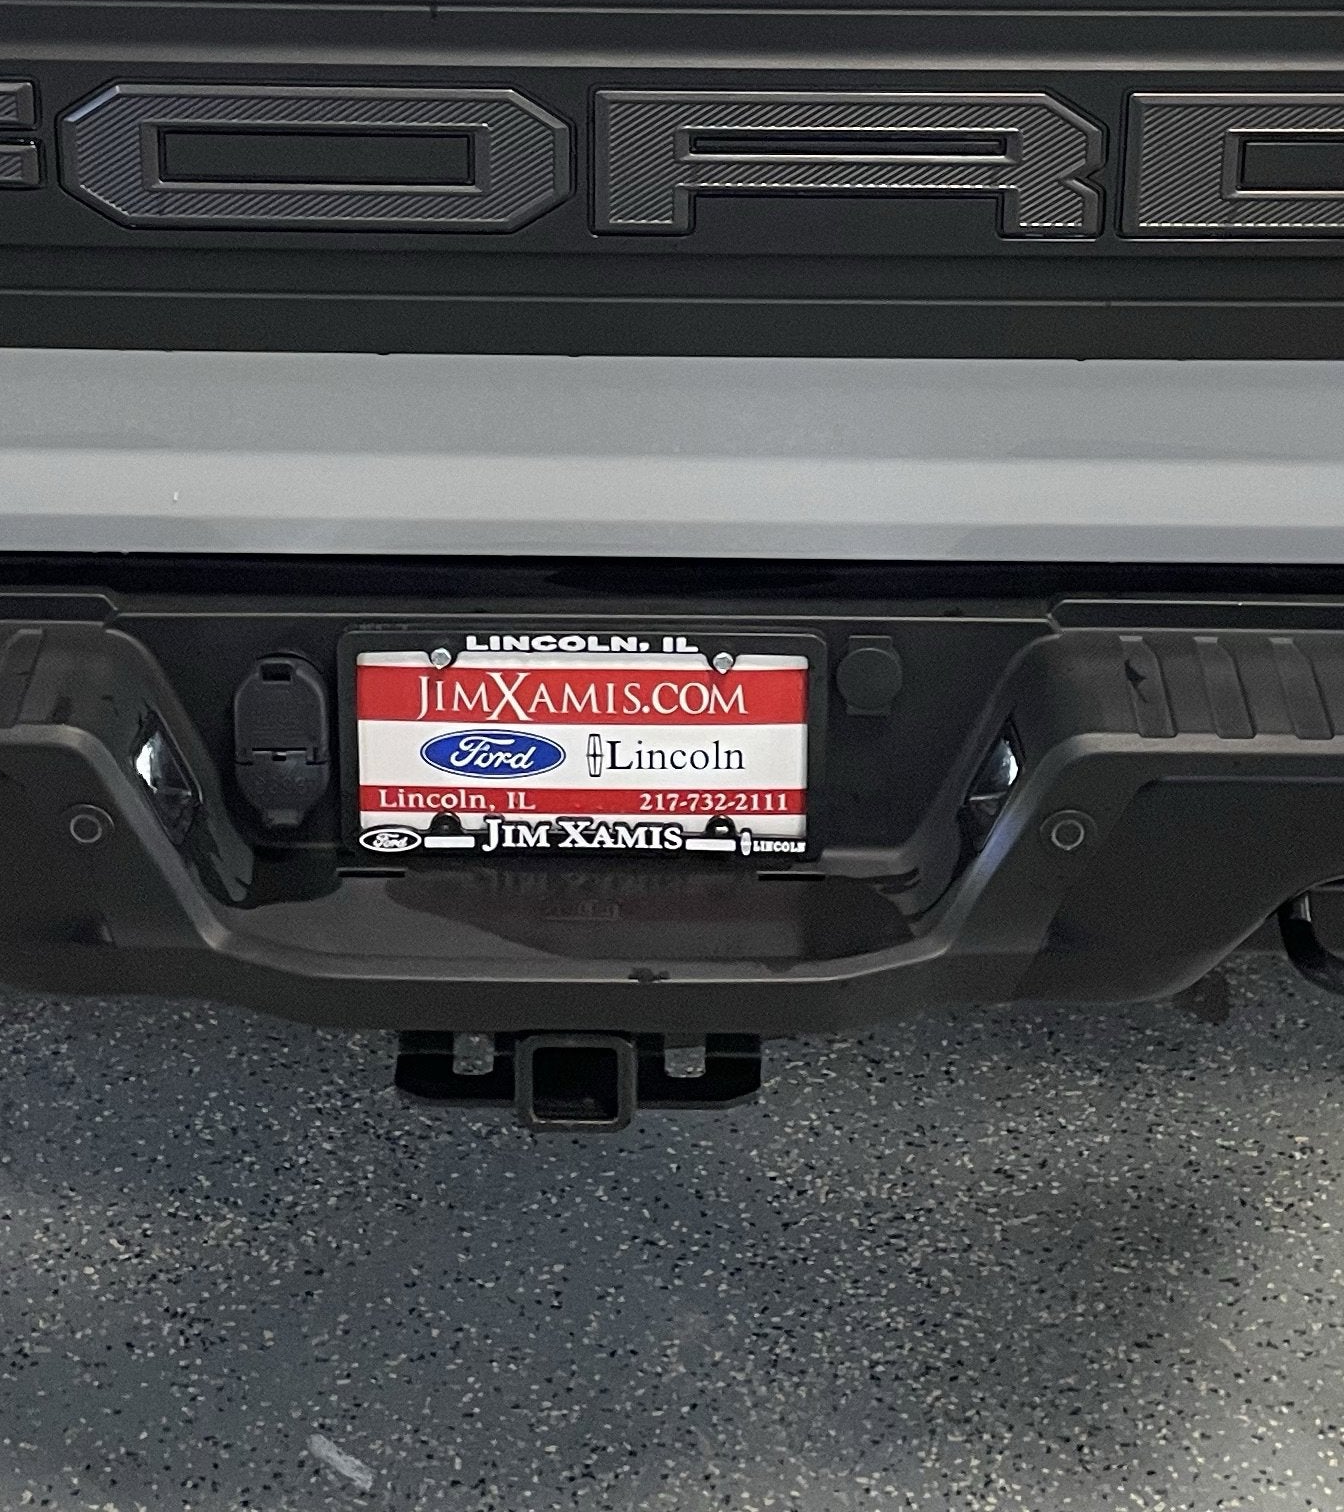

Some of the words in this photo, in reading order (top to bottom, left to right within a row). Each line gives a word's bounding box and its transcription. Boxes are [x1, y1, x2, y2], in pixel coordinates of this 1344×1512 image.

[465, 635, 649, 653] LINCOLN,
[662, 636, 699, 653] IL
[417, 672, 748, 721] JIMXAMIS.COM
[606, 740, 745, 771] Lincoln
[378, 788, 496, 812] Lincoln,
[506, 791, 536, 810] IL
[639, 792, 788, 812] 217-732-2111
[482, 818, 551, 852] JIM
[558, 820, 683, 850] XAMIS
[753, 839, 806, 853] LINCOLN
